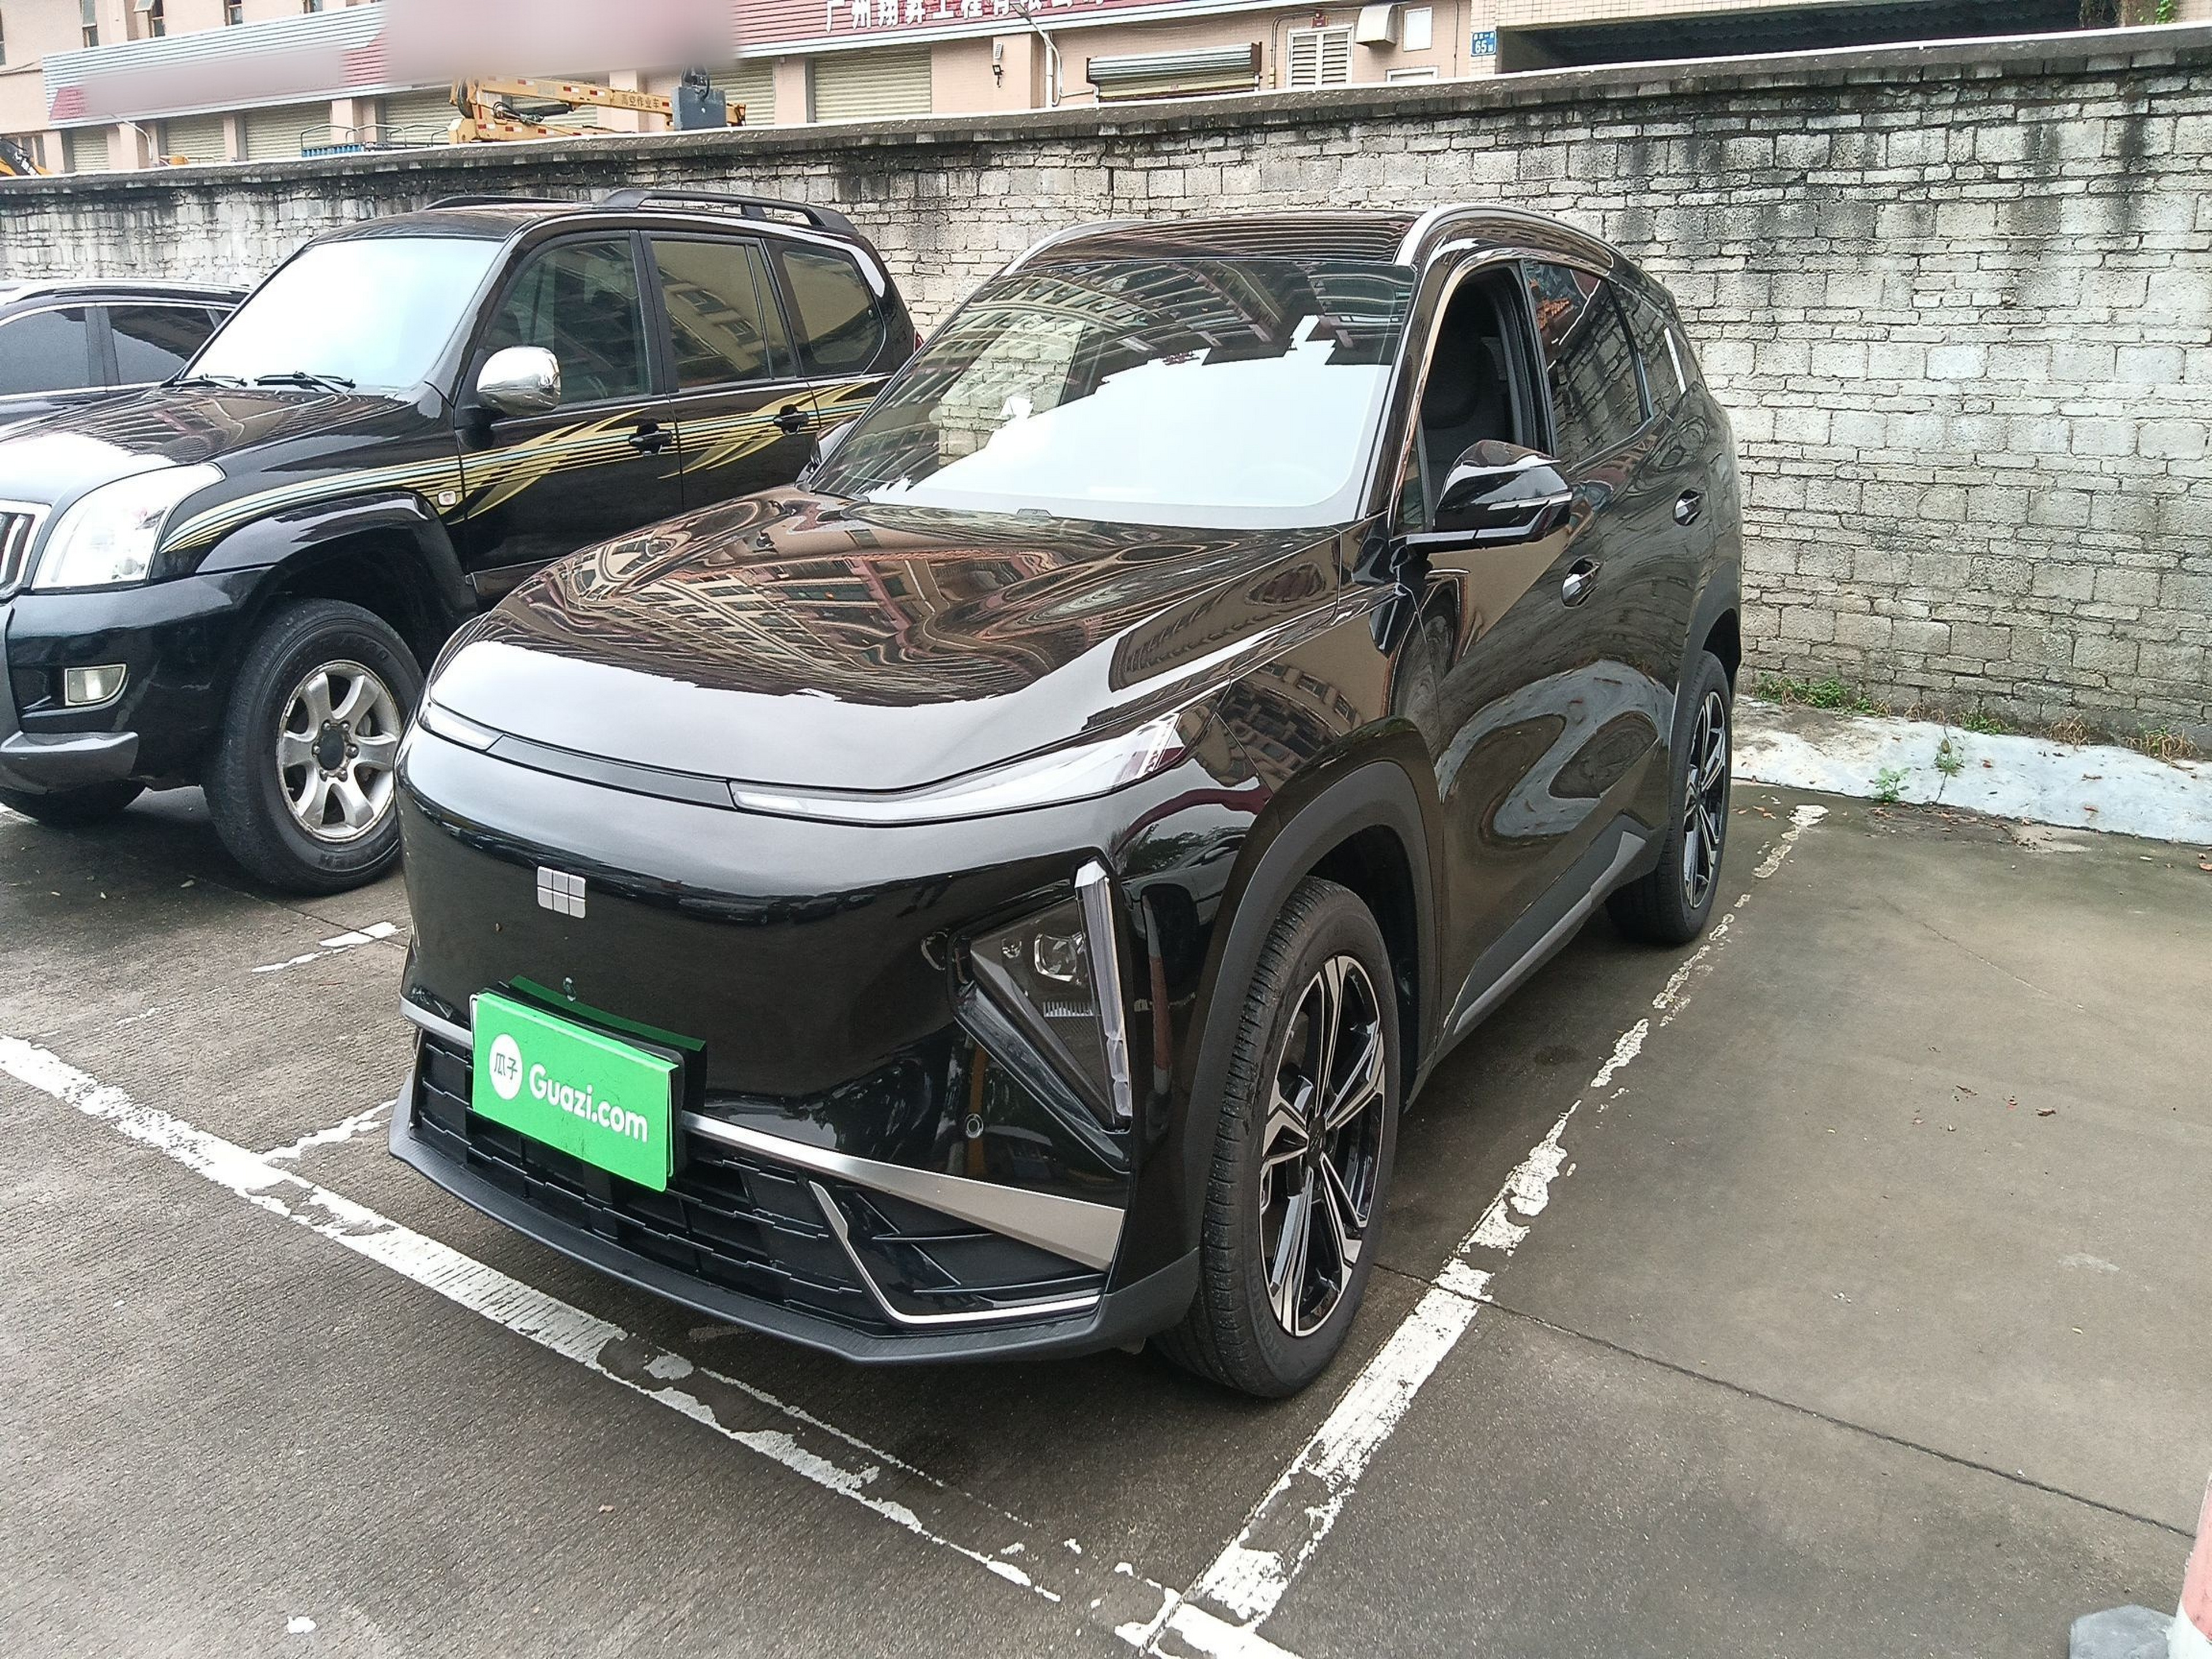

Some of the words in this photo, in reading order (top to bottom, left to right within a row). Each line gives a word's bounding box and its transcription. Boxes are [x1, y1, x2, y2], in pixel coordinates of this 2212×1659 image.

[622, 94, 659, 109] 高空作业车
[494, 1053, 517, 1080] 瓜子
[529, 1063, 648, 1143] Guazi.com
